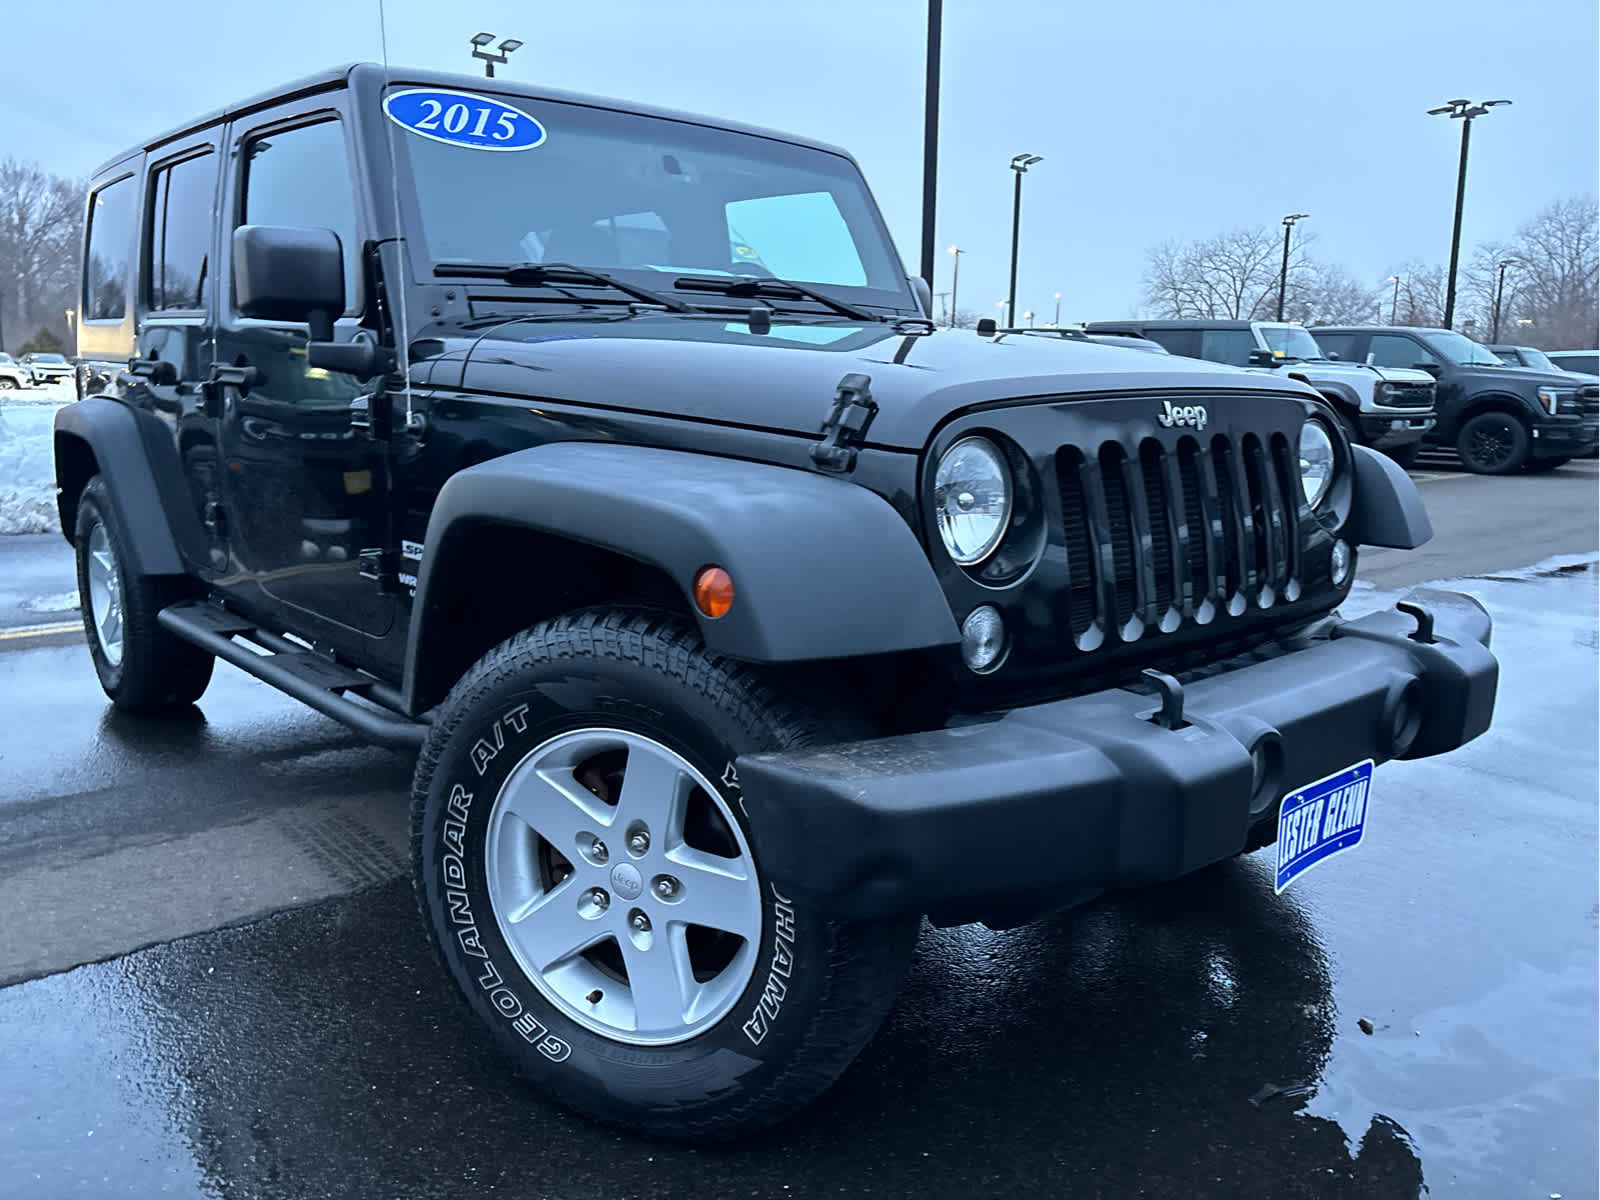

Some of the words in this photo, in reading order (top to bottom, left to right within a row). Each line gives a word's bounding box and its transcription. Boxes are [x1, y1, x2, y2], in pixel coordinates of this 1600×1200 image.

[414, 99, 519, 140] 2015
[1157, 400, 1208, 431] Jeep
[470, 702, 530, 776] A/T
[1279, 799, 1325, 869] LESTER
[1322, 780, 1369, 840] GLENN
[443, 783, 572, 1063] GEOLANDAR
